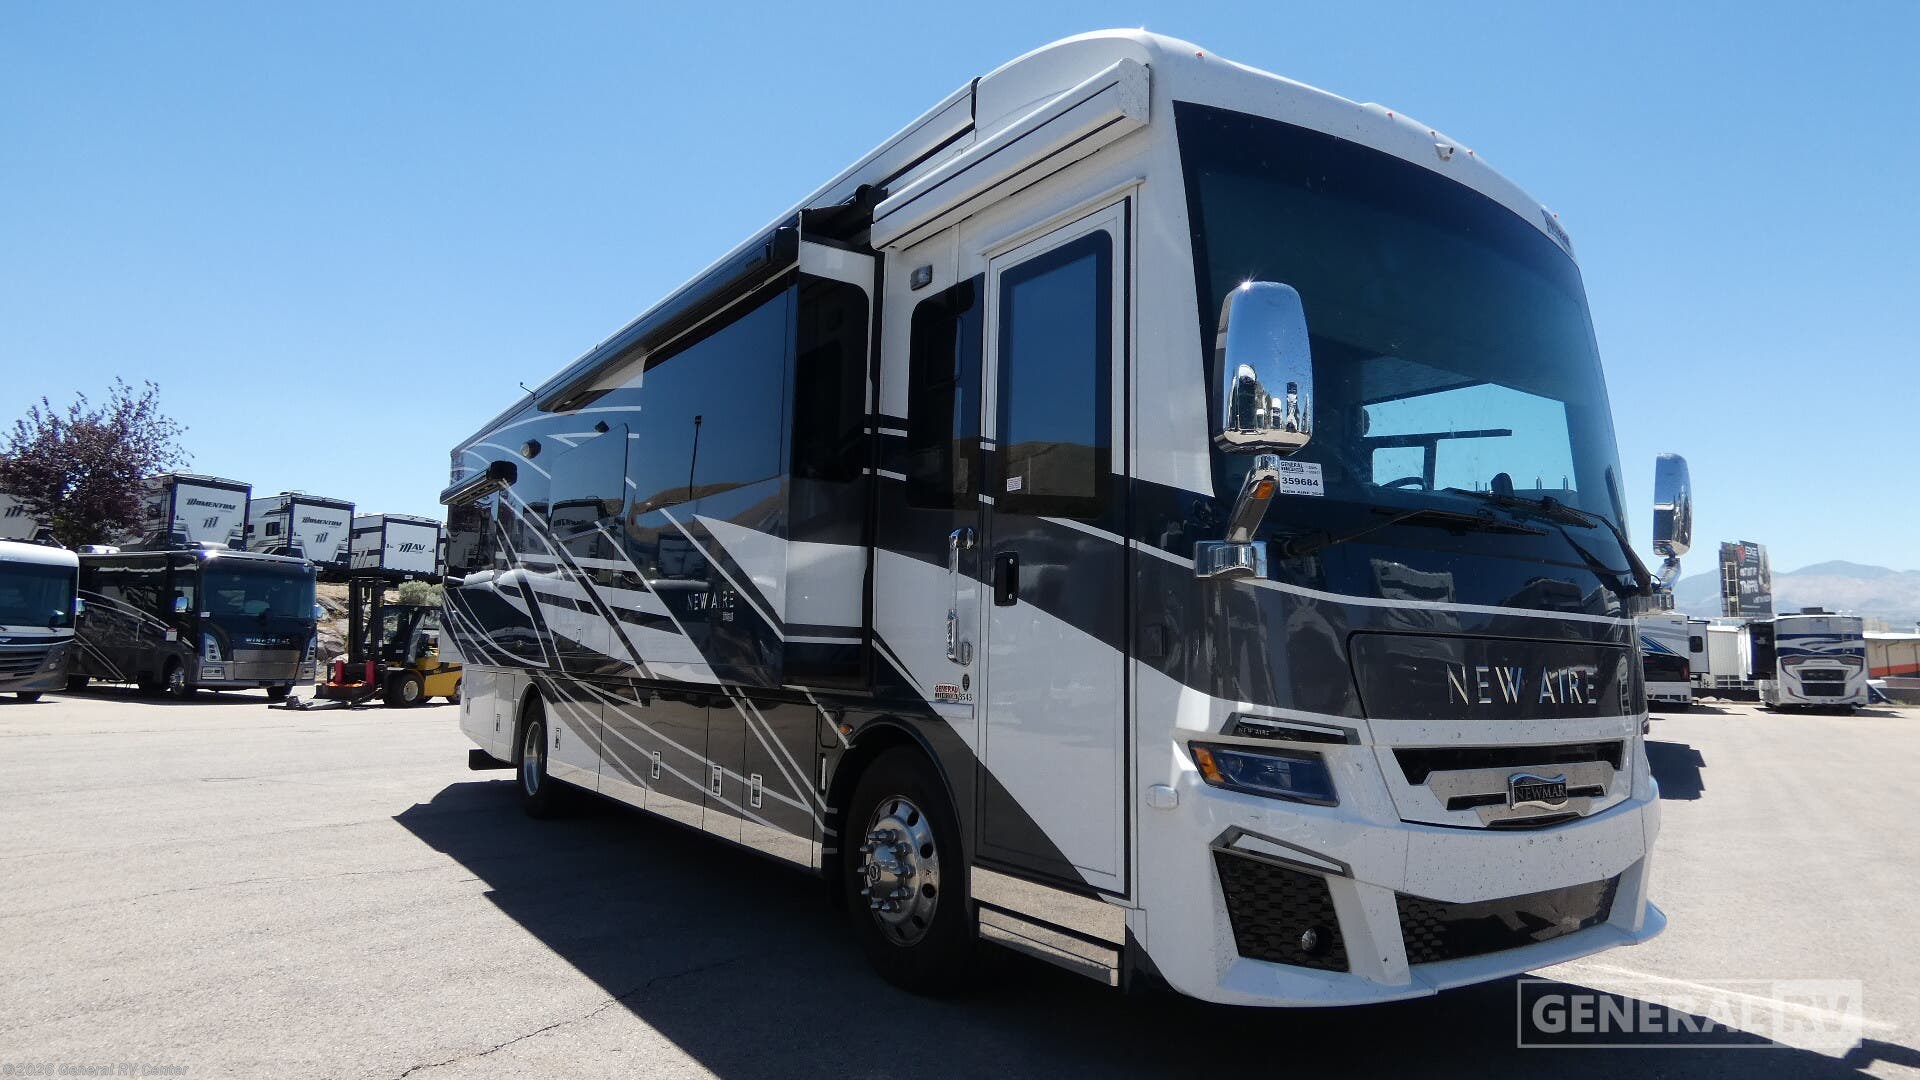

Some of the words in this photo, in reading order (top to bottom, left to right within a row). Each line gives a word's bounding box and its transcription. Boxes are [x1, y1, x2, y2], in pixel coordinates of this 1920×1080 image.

[1282, 477, 1319, 486] 359684
[187, 499, 236, 510] MOMENTUM
[302, 517, 342, 526] MOMENTUM
[688, 593, 708, 610] NEW
[1446, 664, 1522, 705] NEW
[1539, 666, 1598, 704] AIRE
[1515, 784, 1566, 801] NEWMAR
